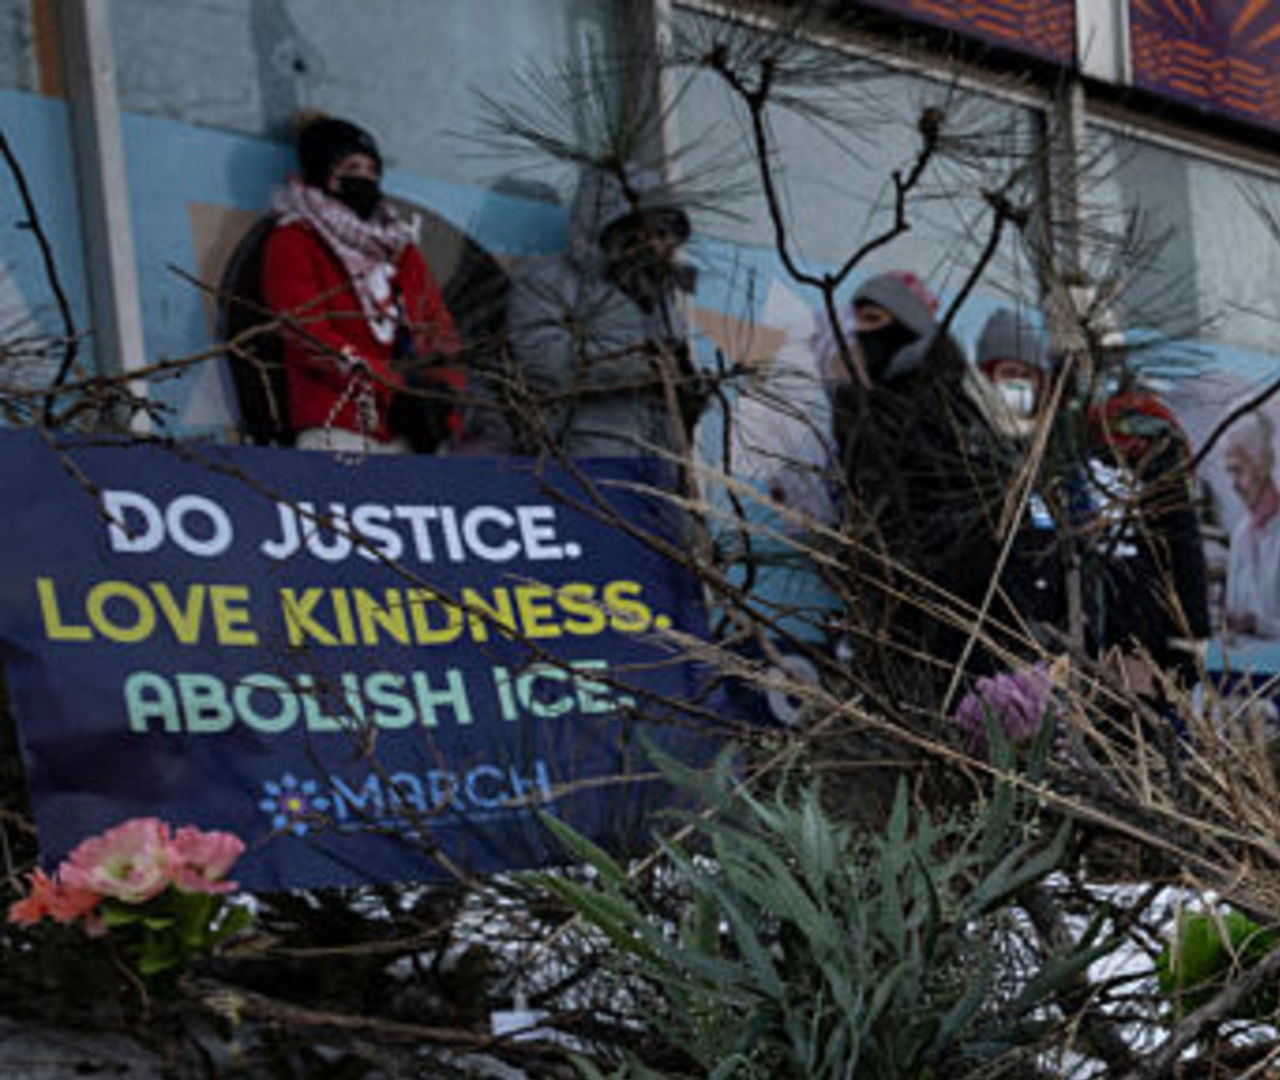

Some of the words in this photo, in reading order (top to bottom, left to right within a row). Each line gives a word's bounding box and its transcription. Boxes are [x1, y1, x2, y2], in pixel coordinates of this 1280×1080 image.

[101, 489, 234, 556] DO
[260, 501, 583, 561] JUSTICE.
[36, 576, 258, 646] LOVE
[278, 580, 673, 647] KINDNESS.
[123, 667, 473, 733] ABOLISH
[493, 659, 636, 722] ICE.
[329, 759, 554, 819] MARCH
